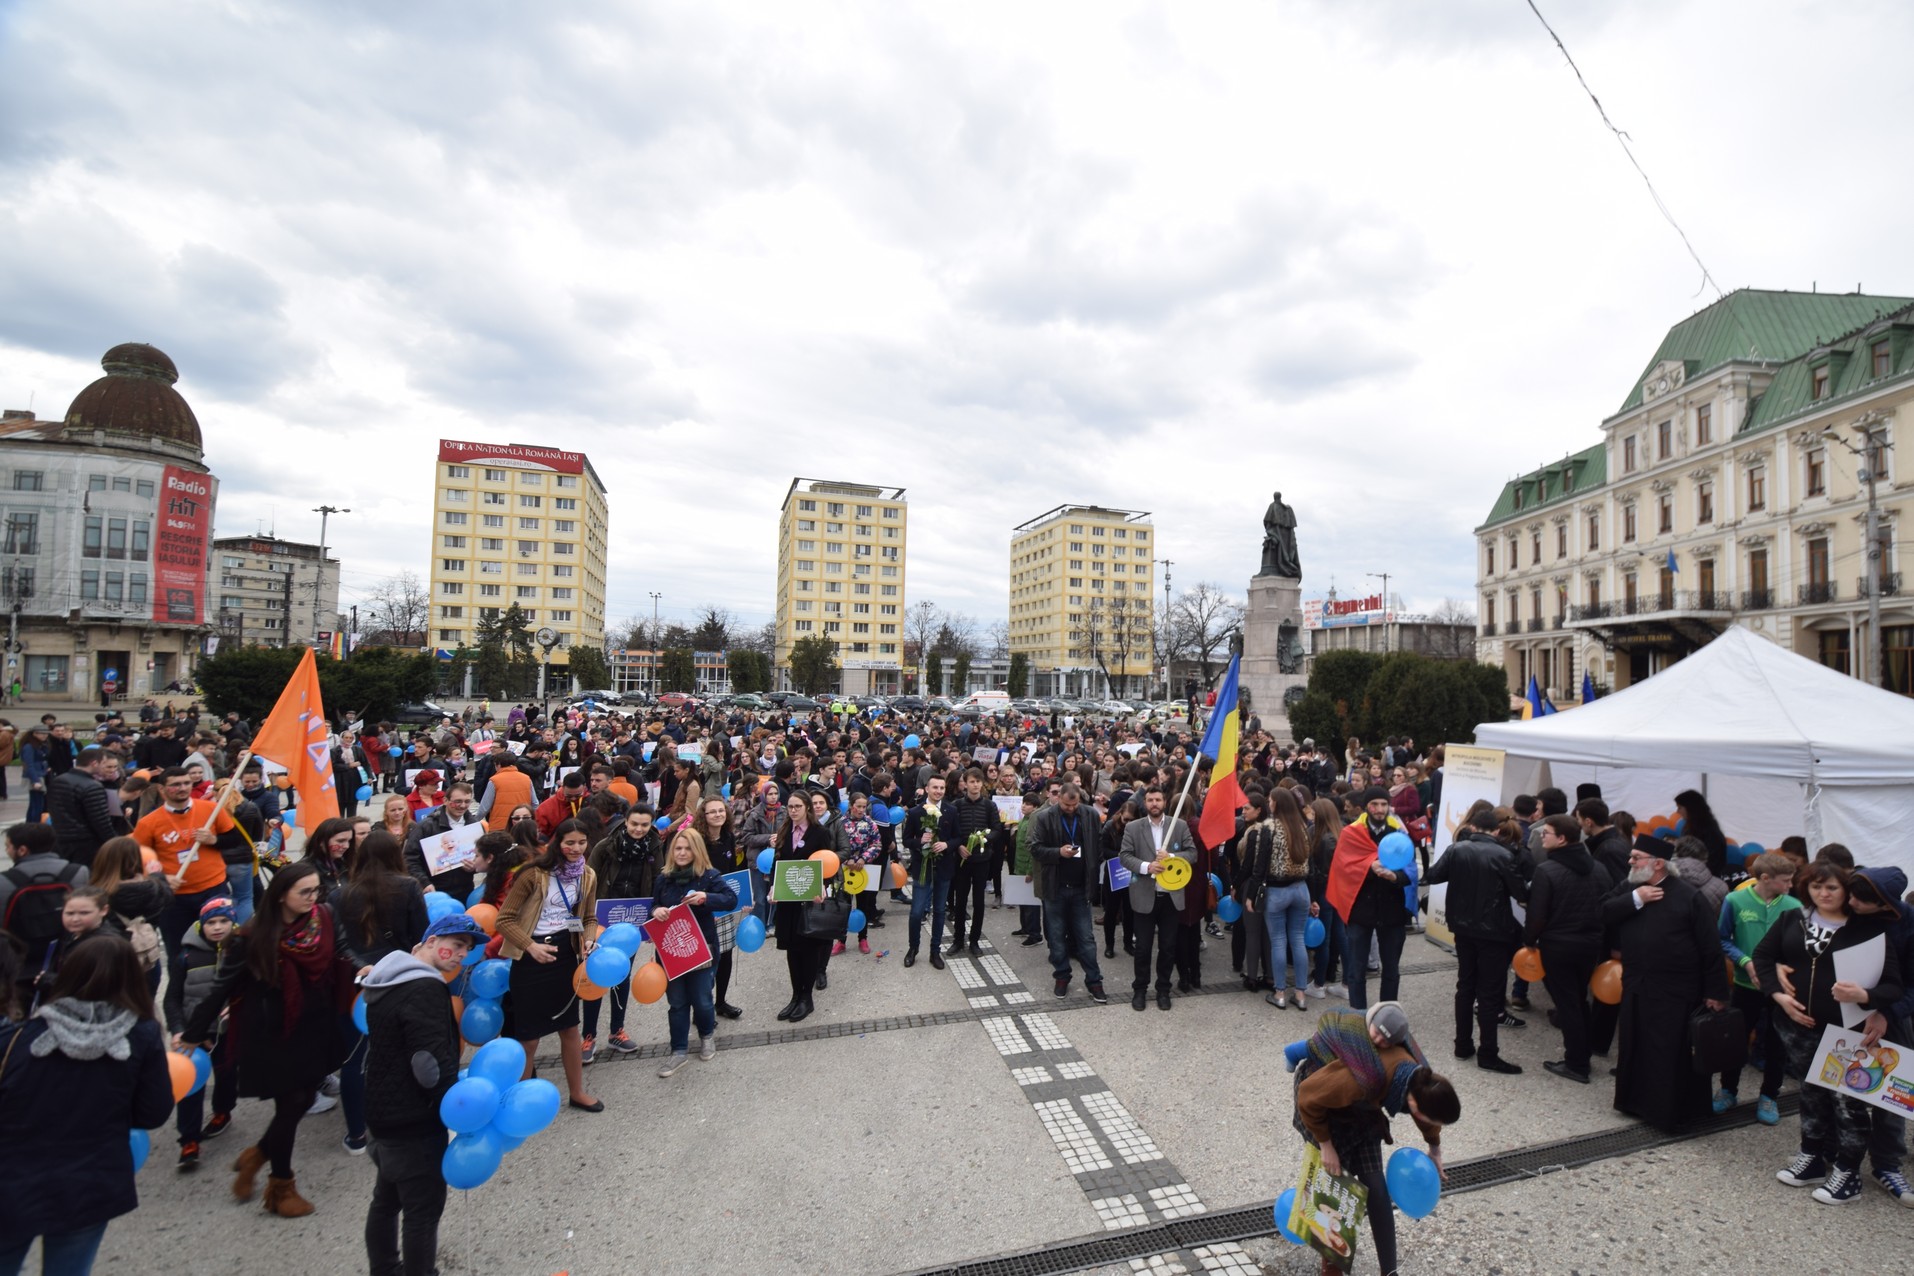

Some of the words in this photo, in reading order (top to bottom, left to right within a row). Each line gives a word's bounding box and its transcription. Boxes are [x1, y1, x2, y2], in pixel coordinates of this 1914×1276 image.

[525, 449, 562, 460] ROMÂNĂ
[168, 476, 206, 495] Radio
[161, 531, 203, 546] RESCRIE
[160, 542, 201, 556] ISTORIA
[1324, 1174, 1333, 1196] mult
[1332, 1181, 1341, 1199] mai
